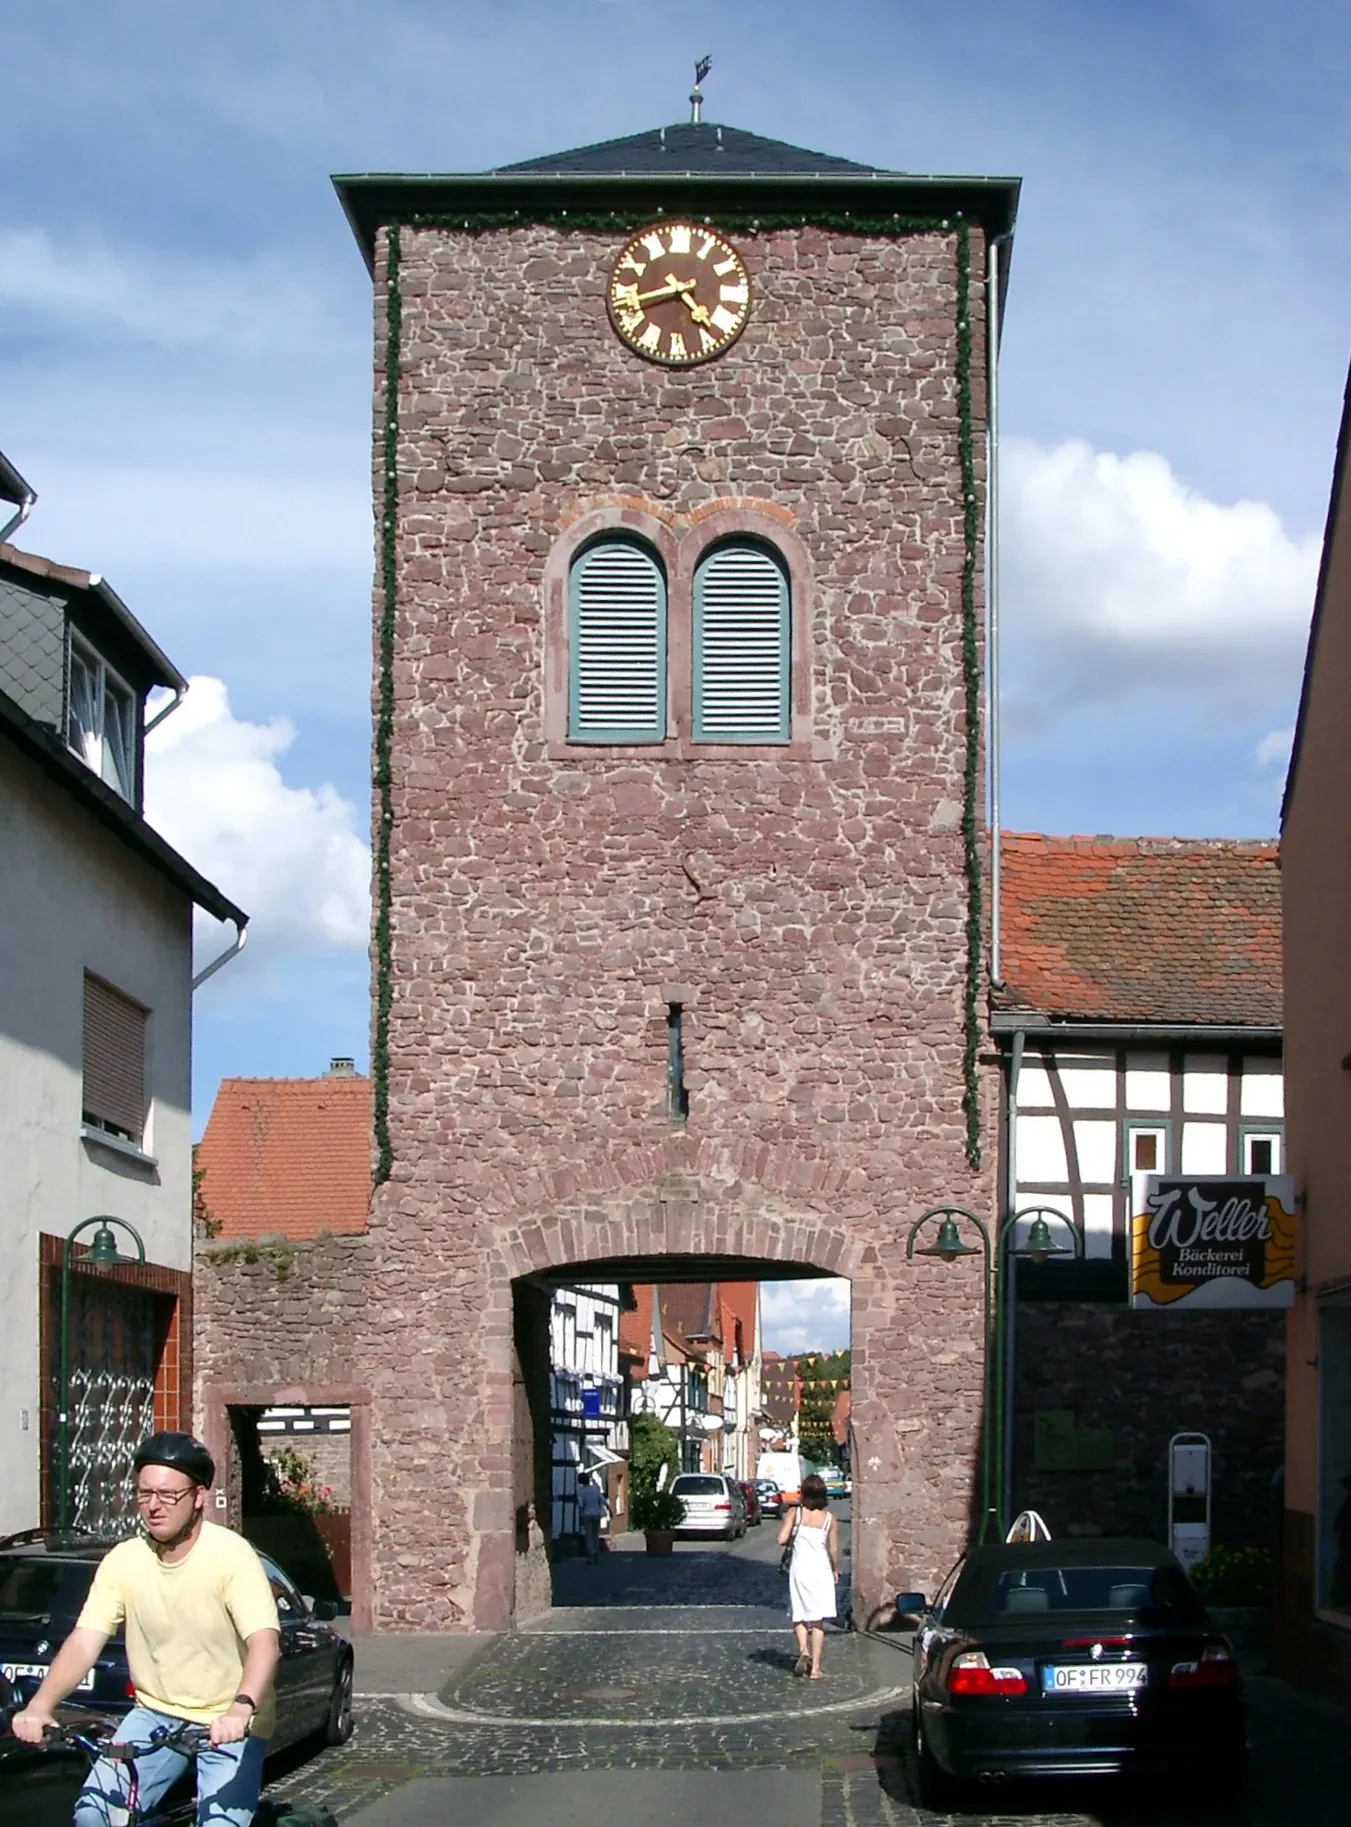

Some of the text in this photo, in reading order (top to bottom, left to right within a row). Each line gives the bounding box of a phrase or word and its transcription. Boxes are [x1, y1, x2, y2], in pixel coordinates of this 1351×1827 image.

[1148, 1186, 1273, 1249] Weller
[1178, 1248, 1244, 1263] Bäckerei
[1172, 1262, 1251, 1277] Konditorei
[1056, 1667, 1147, 1686] OF FR 994
